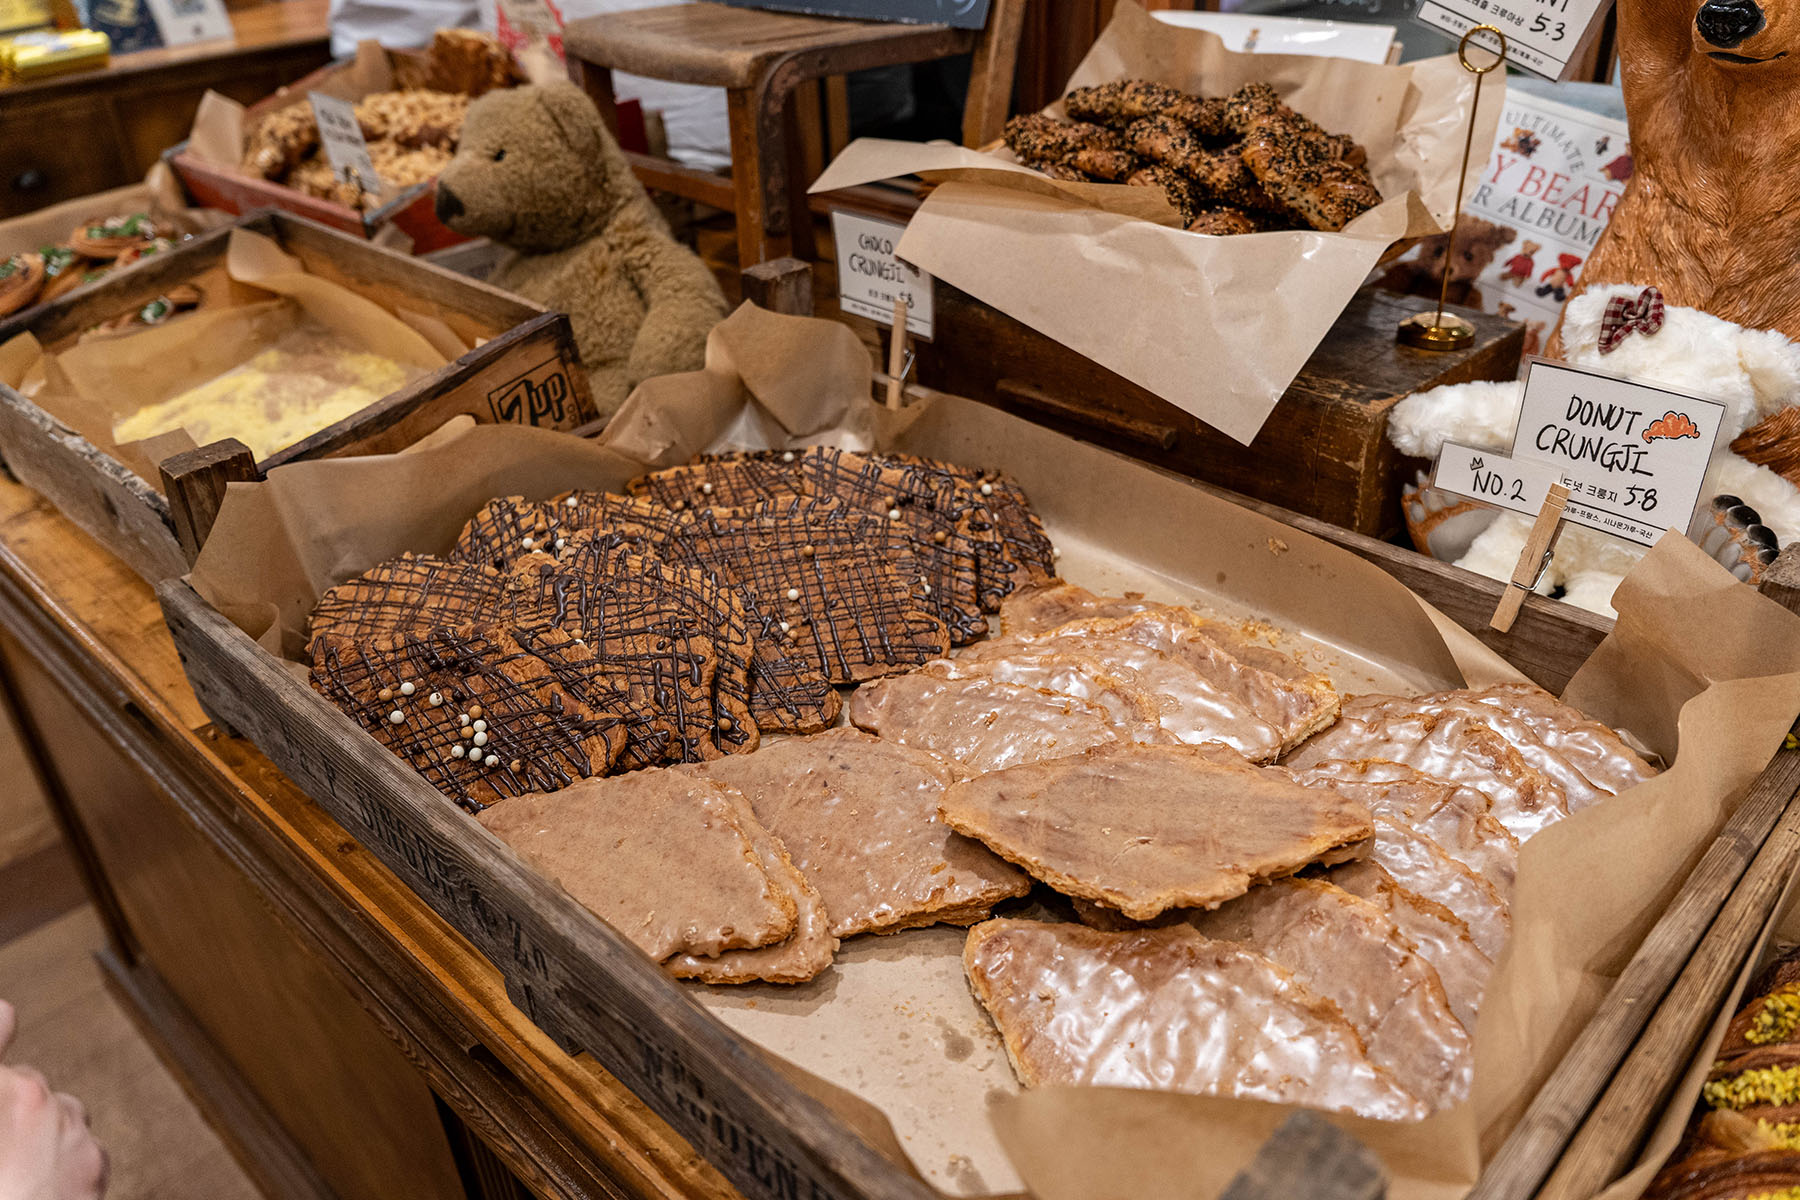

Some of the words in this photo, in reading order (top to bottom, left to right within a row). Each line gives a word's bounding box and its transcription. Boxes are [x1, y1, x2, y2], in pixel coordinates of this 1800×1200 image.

[1530, 12, 1566, 41] 5.3
[1506, 111, 1585, 173] ULTIMATE
[1498, 197, 1604, 246] ALBUM
[858, 233, 893, 255] CHOCO
[1565, 394, 1642, 435] DONUT
[1536, 424, 1654, 477] CRUNGJI
[1586, 484, 1618, 503] 크룽지
[1563, 505, 1601, 523] 가루-프랑스,
